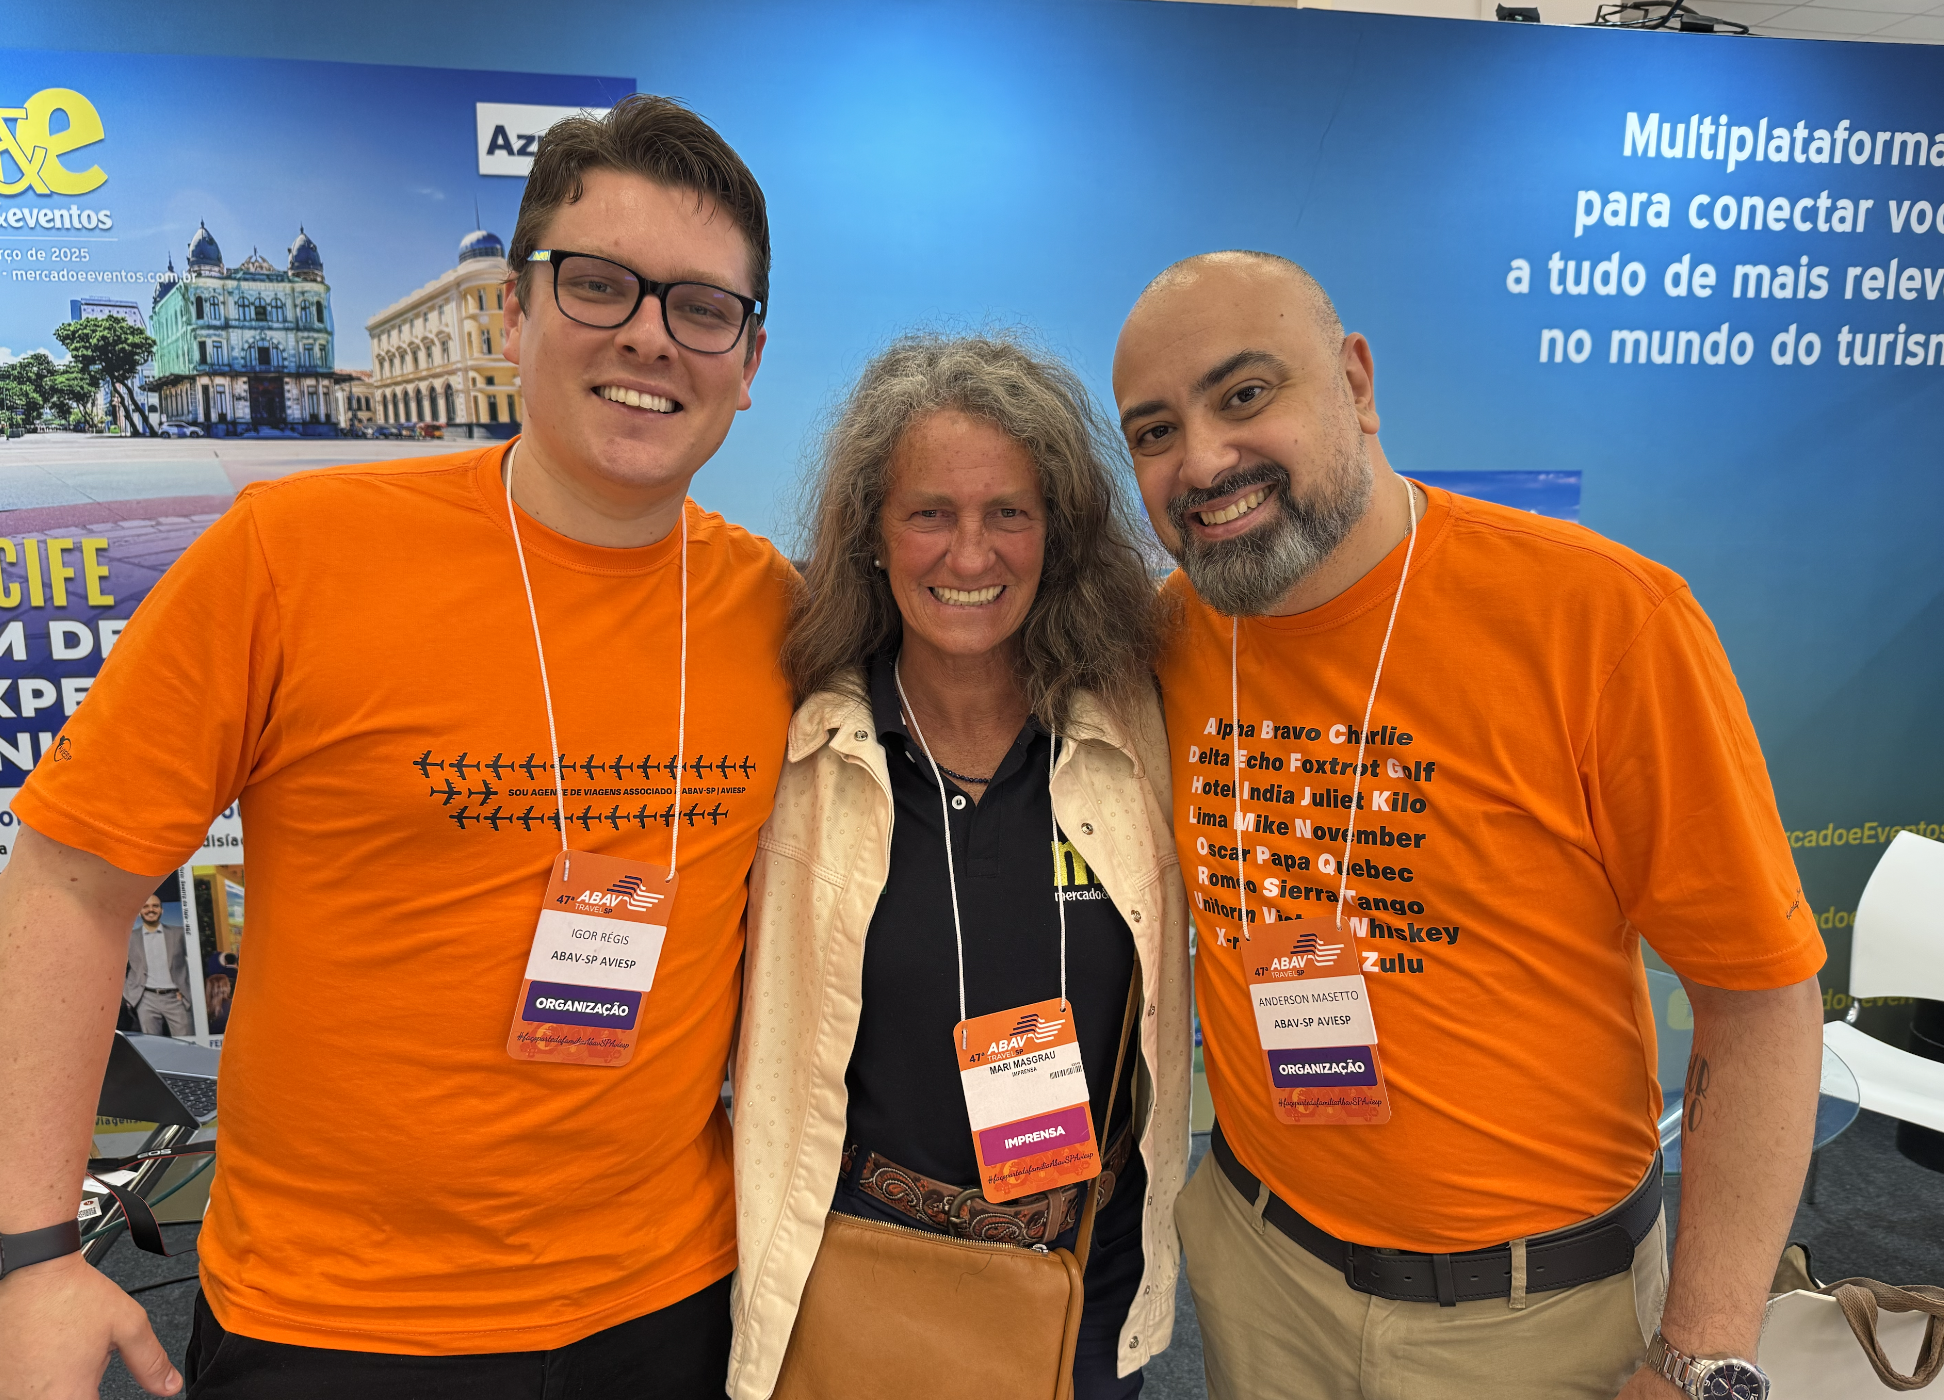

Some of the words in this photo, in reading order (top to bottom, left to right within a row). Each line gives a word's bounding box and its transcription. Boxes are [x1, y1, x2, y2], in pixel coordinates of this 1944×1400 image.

[1623, 111, 1944, 173] Multiplataforma
[1574, 189, 1670, 237] para
[1688, 189, 1874, 233] conectar
[27, 247, 46, 261] de
[51, 248, 90, 261] 2025
[12, 268, 197, 283] mercadoeeventos.com.br
[1506, 257, 1530, 294] a
[1548, 251, 1647, 297] tudo
[1664, 253, 1717, 298] de
[1732, 255, 1829, 300] mais
[1539, 327, 1592, 364] no
[1609, 322, 1755, 366] mundo
[1770, 323, 1822, 366] do
[1204, 717, 1255, 740] Alpha
[1261, 720, 1322, 741] Bravo
[1189, 745, 1230, 767] Delta
[1235, 749, 1284, 772] Echo
[1290, 752, 1380, 778] Foxtrot
[1386, 758, 1436, 782] Golf
[531, 788, 568, 796] AGENE
[570, 788, 582, 796] DE
[584, 788, 621, 796] VIAGENS
[682, 787, 716, 795] ABAV-SP
[1191, 775, 1236, 799] Hotel
[1242, 781, 1295, 805] India
[1301, 786, 1365, 810] Juliet
[1372, 790, 1427, 814] Kilo
[1189, 805, 1228, 828] Lima
[1233, 812, 1290, 836] Mike
[1295, 818, 1427, 848] November
[1196, 837, 1250, 862] Oscar
[1256, 846, 1311, 872] Papa
[1317, 853, 1414, 882] Quebec
[577, 890, 624, 907] ABAV
[1263, 877, 1339, 903] Sierra
[571, 928, 598, 941] IGOR
[600, 930, 630, 945] RÉGIS
[1350, 917, 1460, 945] Whiskey
[551, 950, 598, 965] ABAV-SP
[600, 955, 636, 970] AVIESP
[1270, 954, 1308, 970] ABAV
[1362, 951, 1424, 974] Zulu
[535, 997, 629, 1017] ORGANIZAÇÃO
[1259, 993, 1309, 1007] ANDERSON
[1312, 990, 1359, 1004] MASETTO
[1274, 1017, 1314, 1029] ABAV-SP
[1317, 1015, 1351, 1027] AVIESP
[987, 1034, 1028, 1055] ABAV
[989, 1060, 1012, 1075] MARI
[1013, 1051, 1056, 1069] MASGRAU
[1279, 1059, 1365, 1076] ORGANIZAÇÃO
[1004, 1125, 1066, 1150] IMPRENSA
